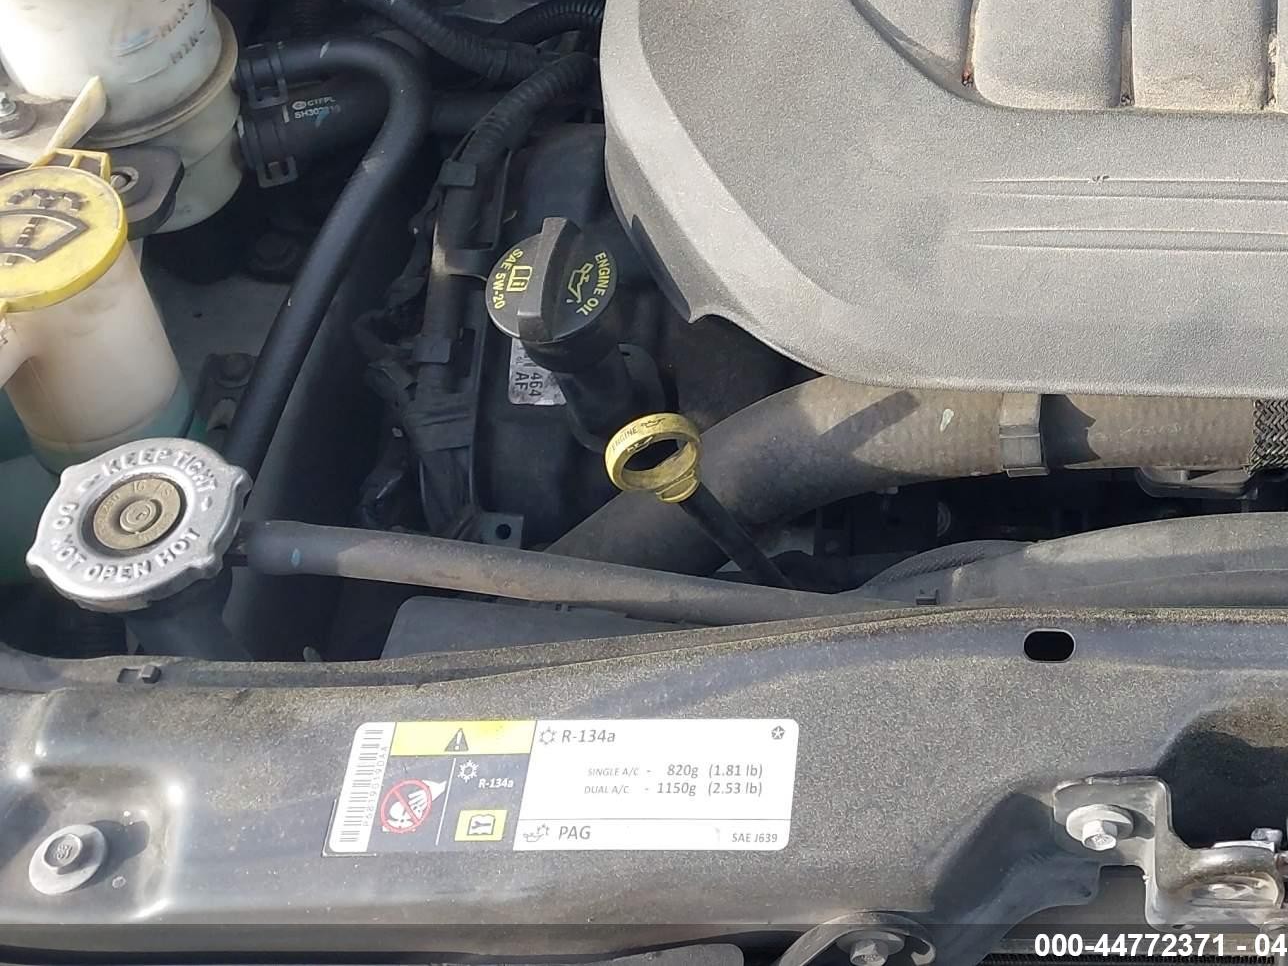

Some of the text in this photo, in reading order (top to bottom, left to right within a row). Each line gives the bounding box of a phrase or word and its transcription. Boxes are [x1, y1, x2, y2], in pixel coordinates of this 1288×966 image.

[493, 248, 524, 309] SAE 5W-20
[576, 251, 612, 316] ENGINE OIL
[515, 372, 529, 392] AF
[529, 372, 542, 397] 464
[611, 426, 638, 451] ENGINE
[101, 448, 171, 477] KEEP
[175, 451, 219, 494] TIGHT
[53, 502, 79, 530] DO
[86, 560, 152, 582] OPEN
[155, 527, 201, 568] HOT
[561, 729, 616, 743] R-134a
[587, 768, 620, 777] SINGLE
[622, 767, 639, 777] A/C
[667, 764, 699, 779] 820g
[708, 764, 741, 779] (1.81
[746, 764, 764, 778] lb)
[478, 777, 514, 789] R-134a
[584, 786, 611, 795] DUAL
[612, 786, 630, 795] A/C
[657, 782, 697, 797] 1150g
[708, 782, 741, 797] (2.53
[745, 782, 763, 797] lb)
[559, 825, 592, 840] PAG
[732, 833, 778, 843] SAE J639
